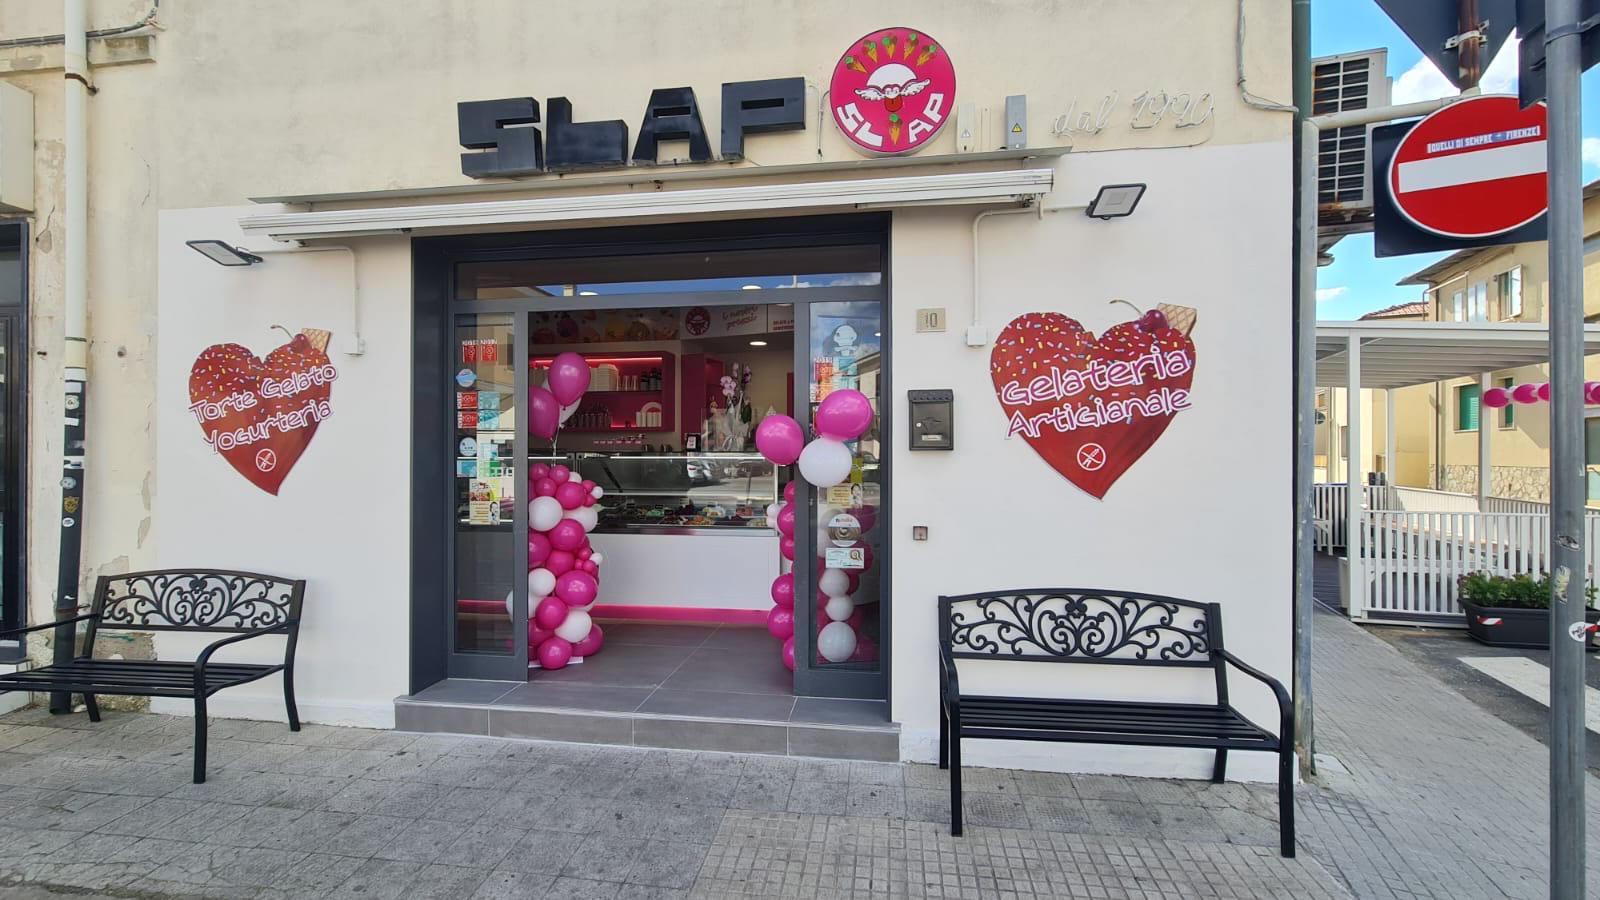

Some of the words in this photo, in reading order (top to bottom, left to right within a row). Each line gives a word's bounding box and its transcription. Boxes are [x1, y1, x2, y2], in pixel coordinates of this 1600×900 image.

[457, 77, 806, 178] SLAP
[836, 92, 945, 147] SLAP
[1052, 90, 1118, 135] dal
[1129, 90, 1214, 129] 1990
[1430, 139, 1455, 153] QUELLI
[1455, 137, 1464, 149] DI
[1464, 134, 1493, 147] SEMPRE
[1505, 126, 1538, 141] FIRENZE
[925, 312, 938, 328] 10
[189, 391, 258, 424] Torte
[261, 364, 338, 399] Gelato
[1001, 344, 1190, 406] Gelateria
